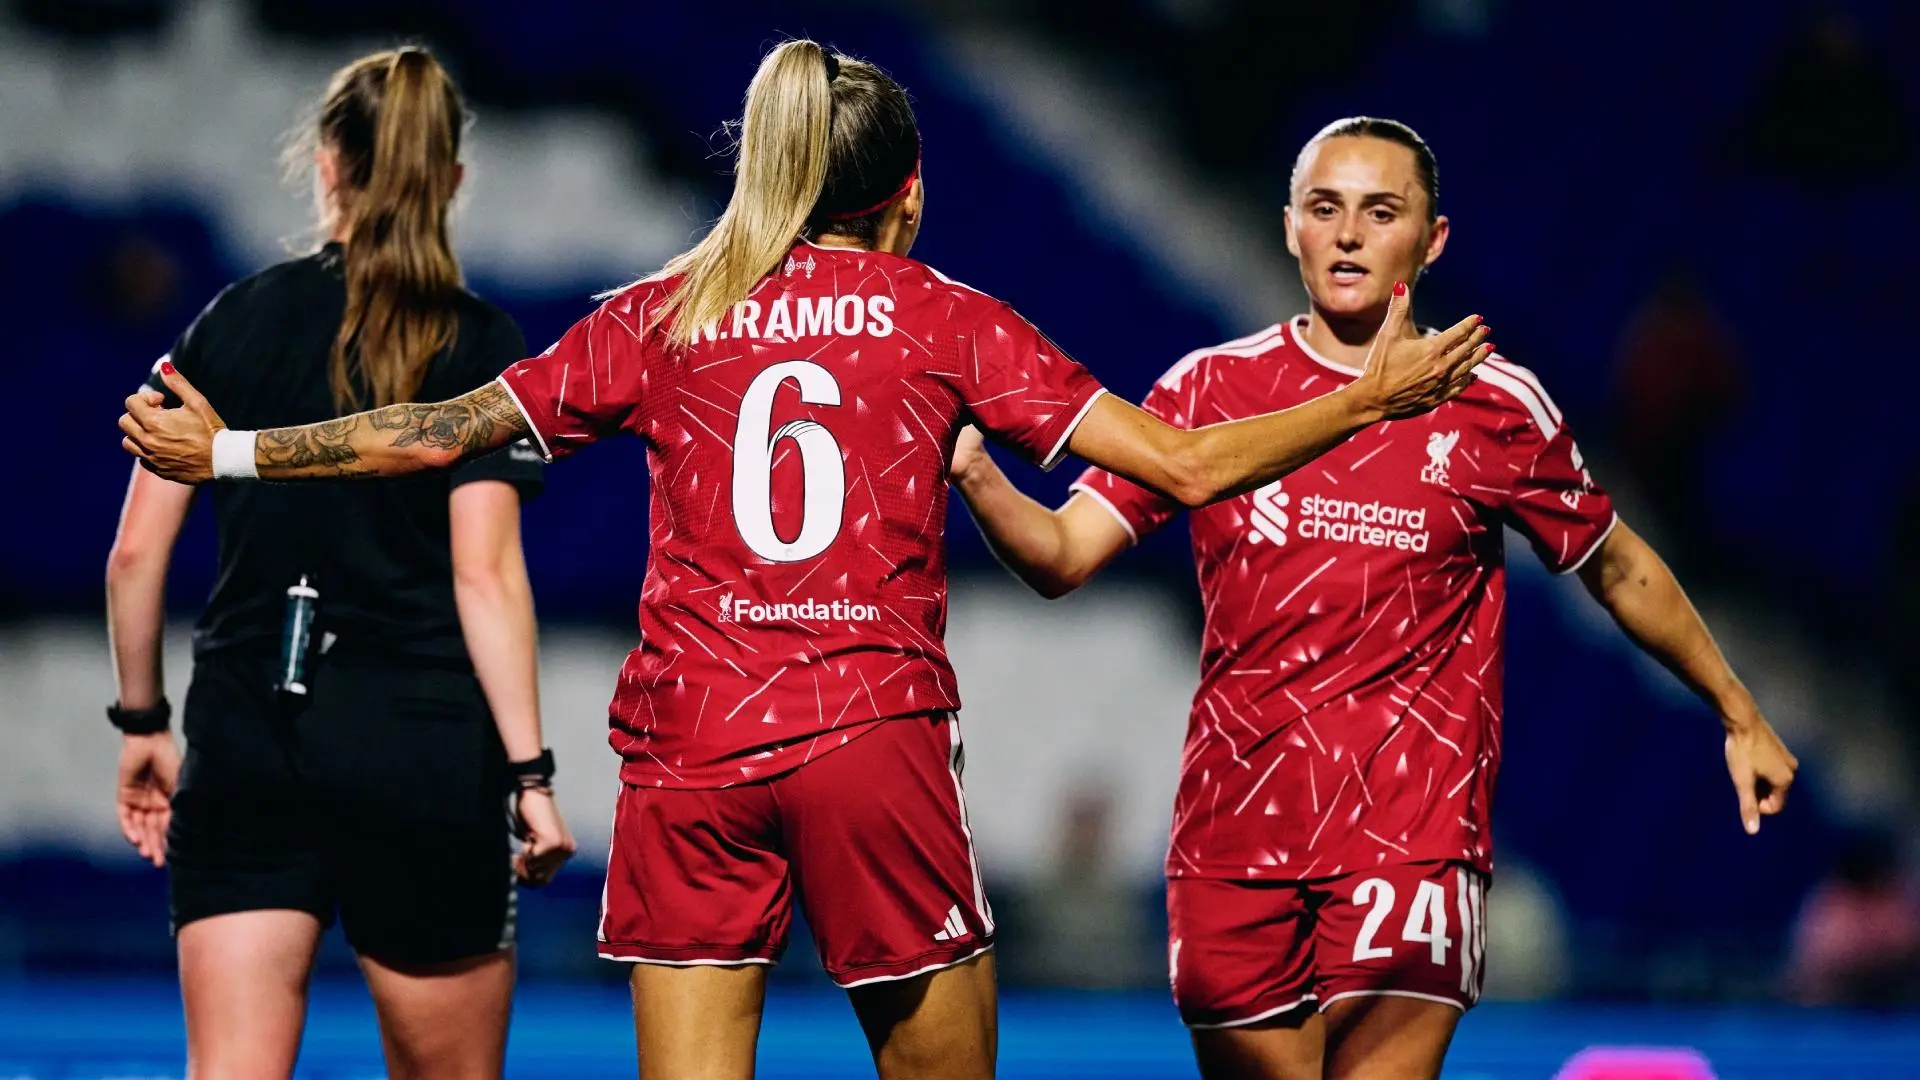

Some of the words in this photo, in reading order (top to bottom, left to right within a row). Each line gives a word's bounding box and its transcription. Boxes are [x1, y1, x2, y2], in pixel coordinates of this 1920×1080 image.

[795, 261, 807, 270] 97
[730, 359, 846, 564] 6
[1420, 465, 1451, 488] LFC
[1299, 493, 1427, 530] standard
[1297, 516, 1431, 553] chartered
[734, 597, 882, 622] Foundation
[1352, 877, 1452, 967] 24
